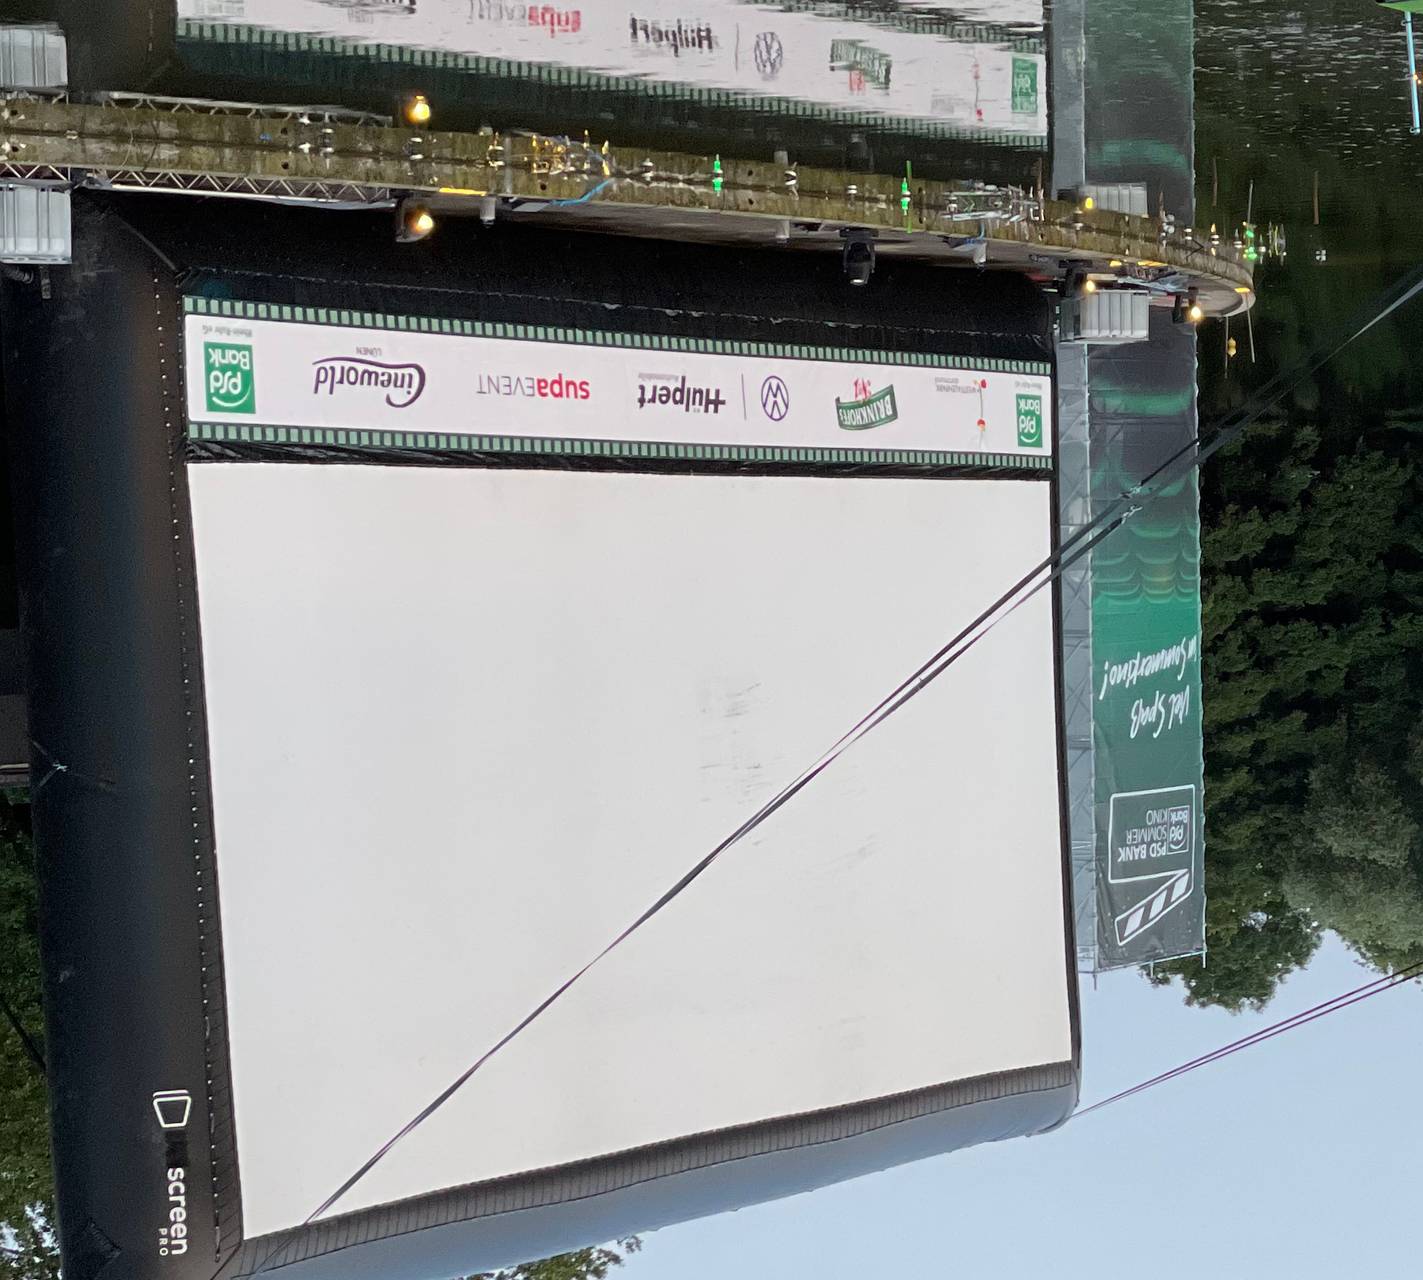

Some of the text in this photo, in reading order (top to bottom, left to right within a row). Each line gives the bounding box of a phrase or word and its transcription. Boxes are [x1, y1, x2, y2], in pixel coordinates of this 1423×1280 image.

[208, 348, 249, 370] Bank
[312, 357, 426, 408] Cineworld
[477, 373, 590, 399] supaEVENT
[638, 376, 726, 413] Hülpert
[1018, 398, 1040, 415] Bank
[1099, 636, 1187, 701] Sommerkino!
[1130, 685, 1190, 739] Viel Spaß
[1146, 808, 1168, 825] KINO
[1170, 810, 1188, 824] Bank
[1126, 825, 1167, 845] SOMMER
[1117, 841, 1167, 862] PSD BANK
[158, 1228, 169, 1256] PRO
